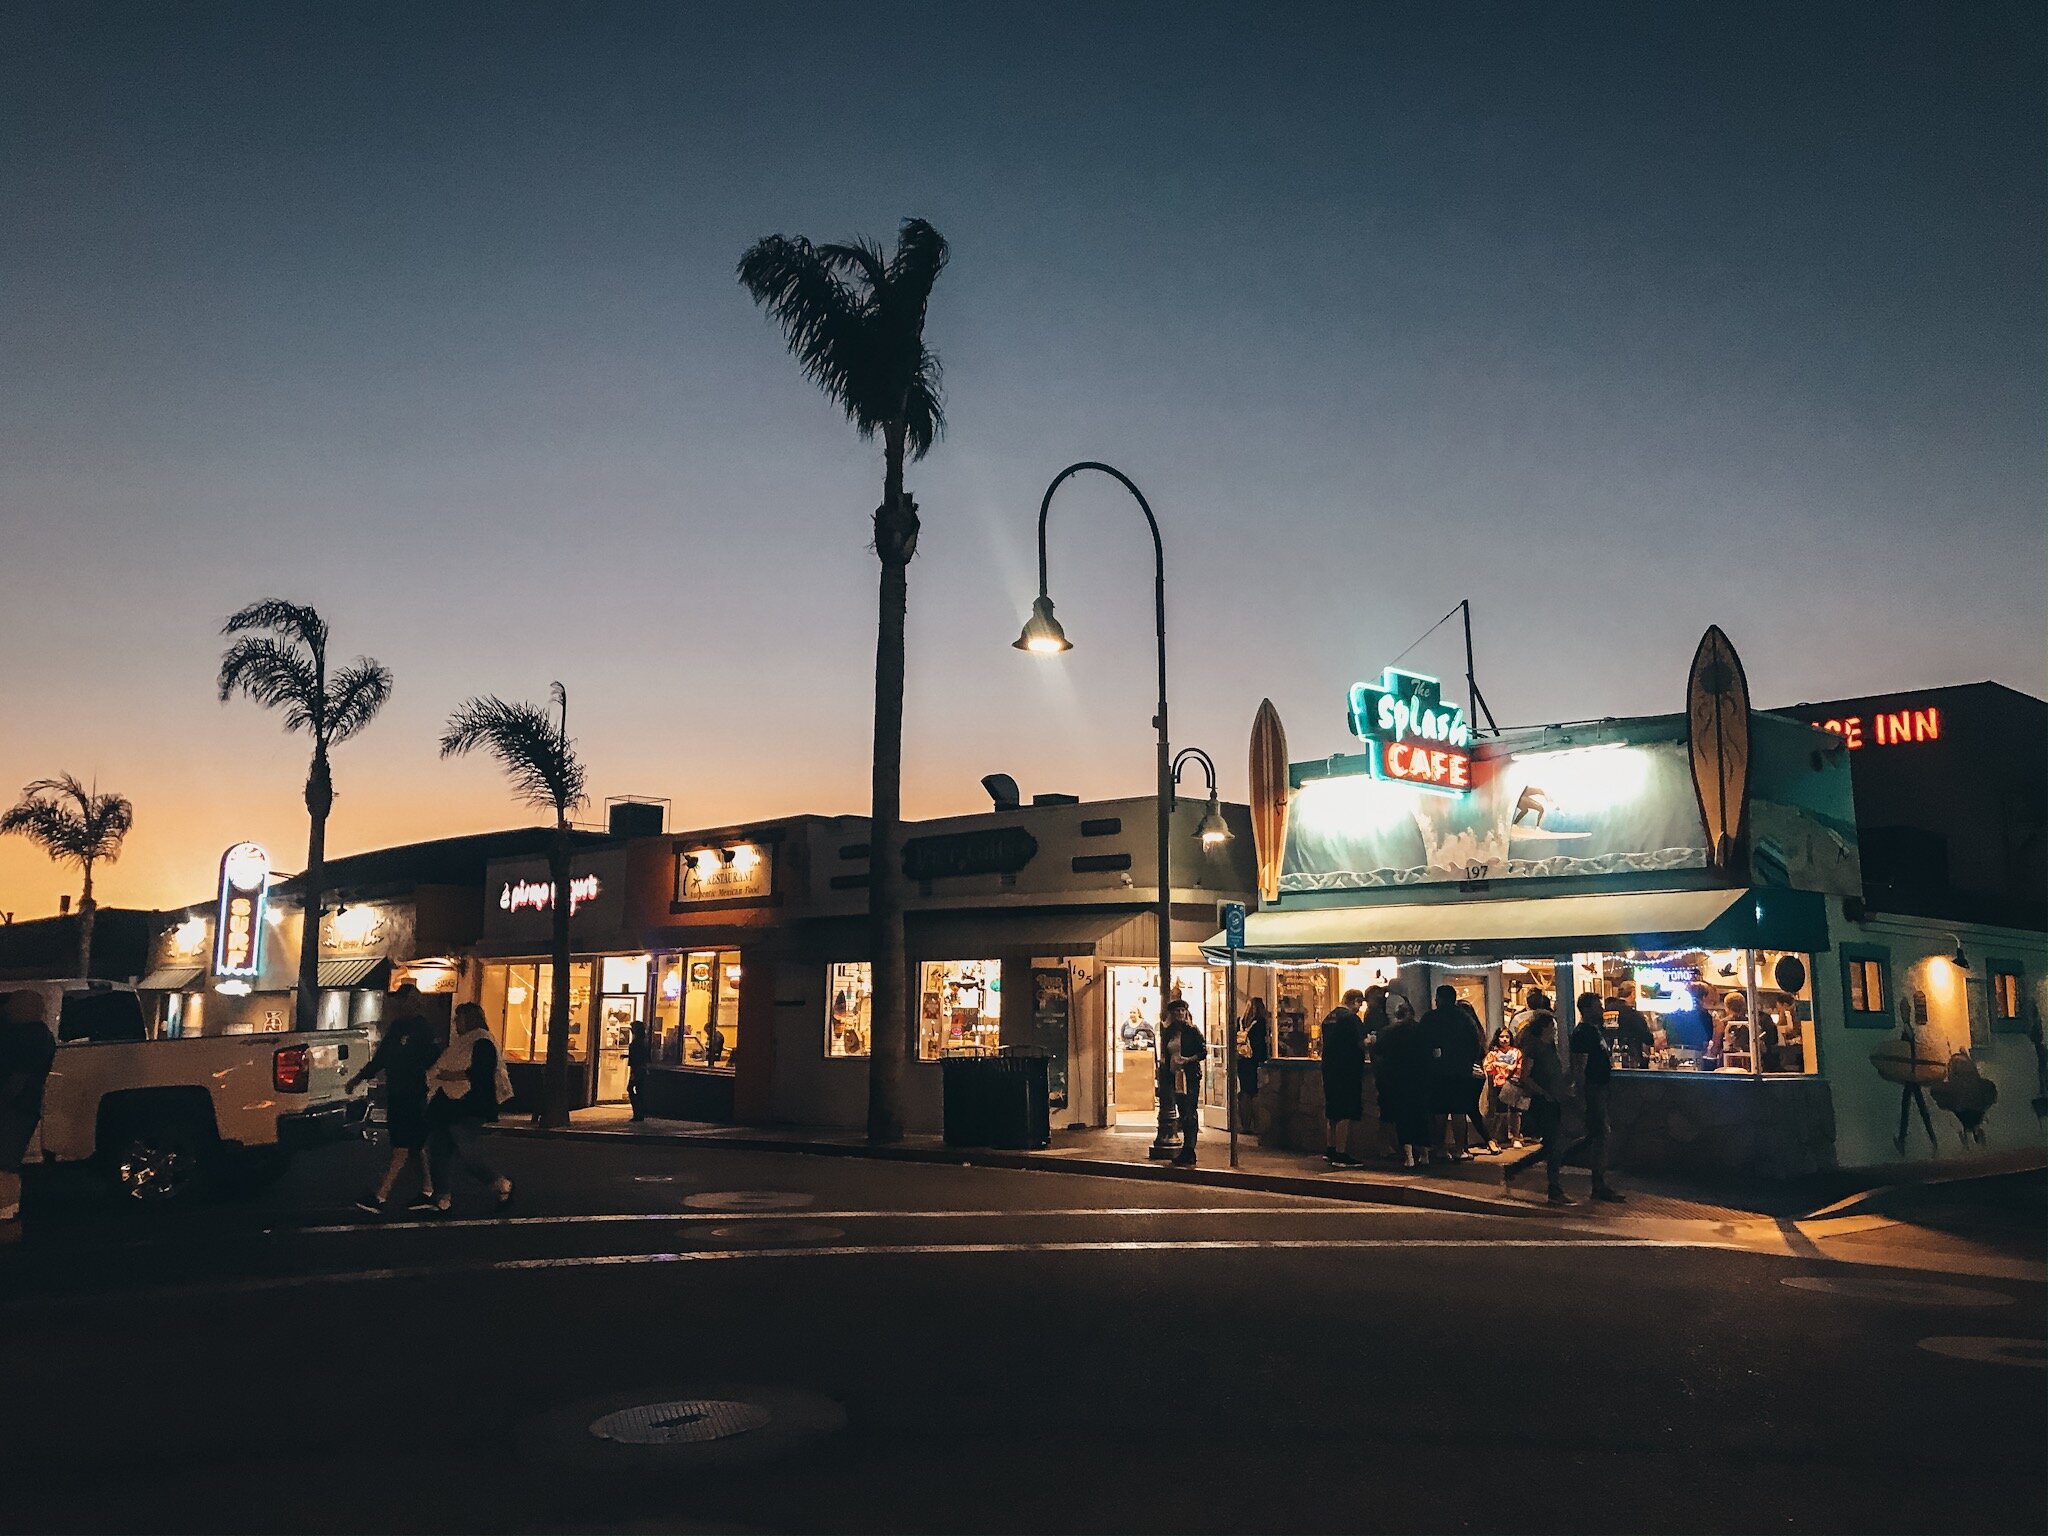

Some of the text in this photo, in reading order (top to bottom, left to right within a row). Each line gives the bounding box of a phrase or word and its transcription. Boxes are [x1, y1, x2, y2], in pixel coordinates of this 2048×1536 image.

[1410, 678, 1430, 698] The
[1875, 705, 1940, 746] INN
[1388, 743, 1468, 786] CAFE
[707, 870, 753, 886] RESTAURANT
[1465, 865, 1489, 880] 197
[718, 887, 743, 897] Mexican
[745, 885, 760, 895] Food
[227, 898, 251, 970] SURF
[1379, 943, 1457, 956] SPLASH CAFE
[1072, 964, 1093, 986] 195
